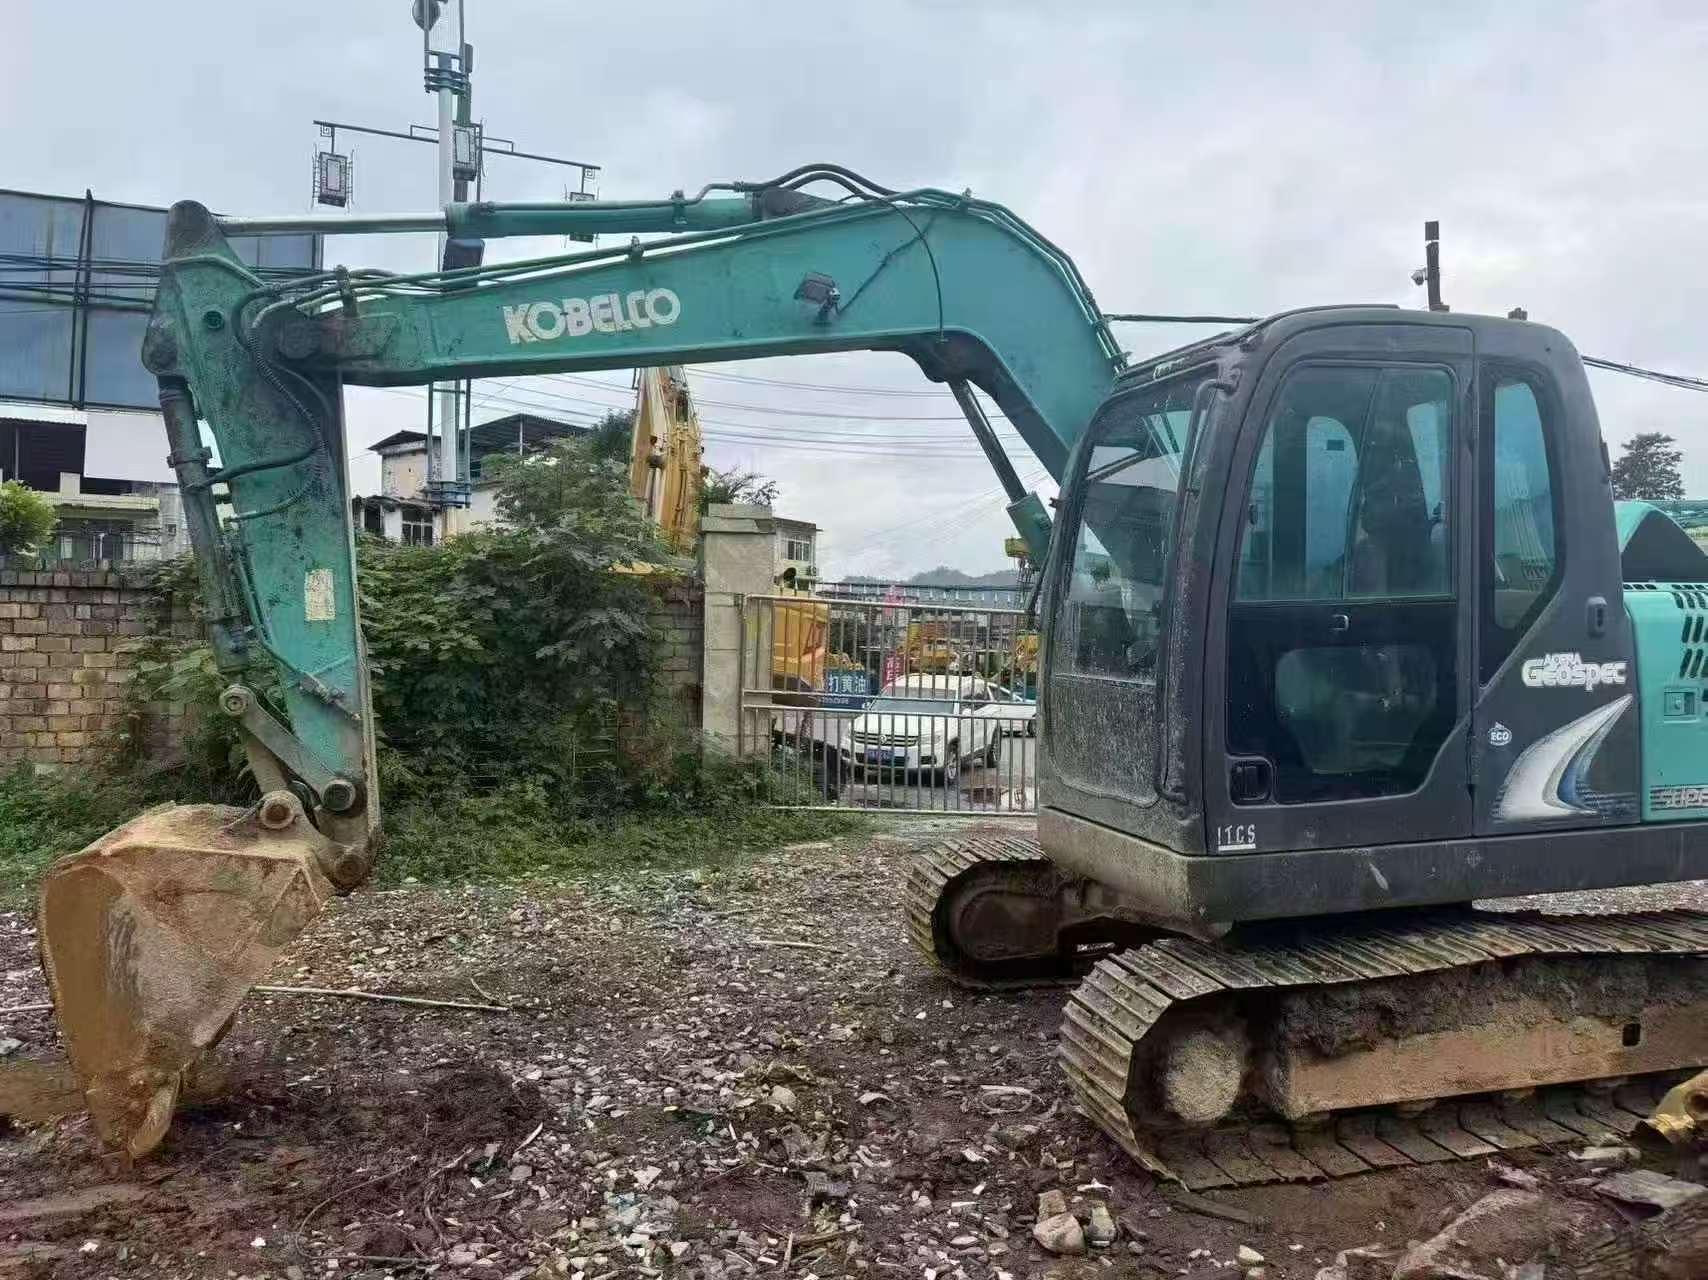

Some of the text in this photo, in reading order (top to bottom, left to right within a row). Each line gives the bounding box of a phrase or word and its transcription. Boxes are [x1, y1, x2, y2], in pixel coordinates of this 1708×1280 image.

[503, 288, 681, 345] KOBELCO
[1490, 731, 1510, 741] ECO
[1217, 824, 1256, 845] ITCS
